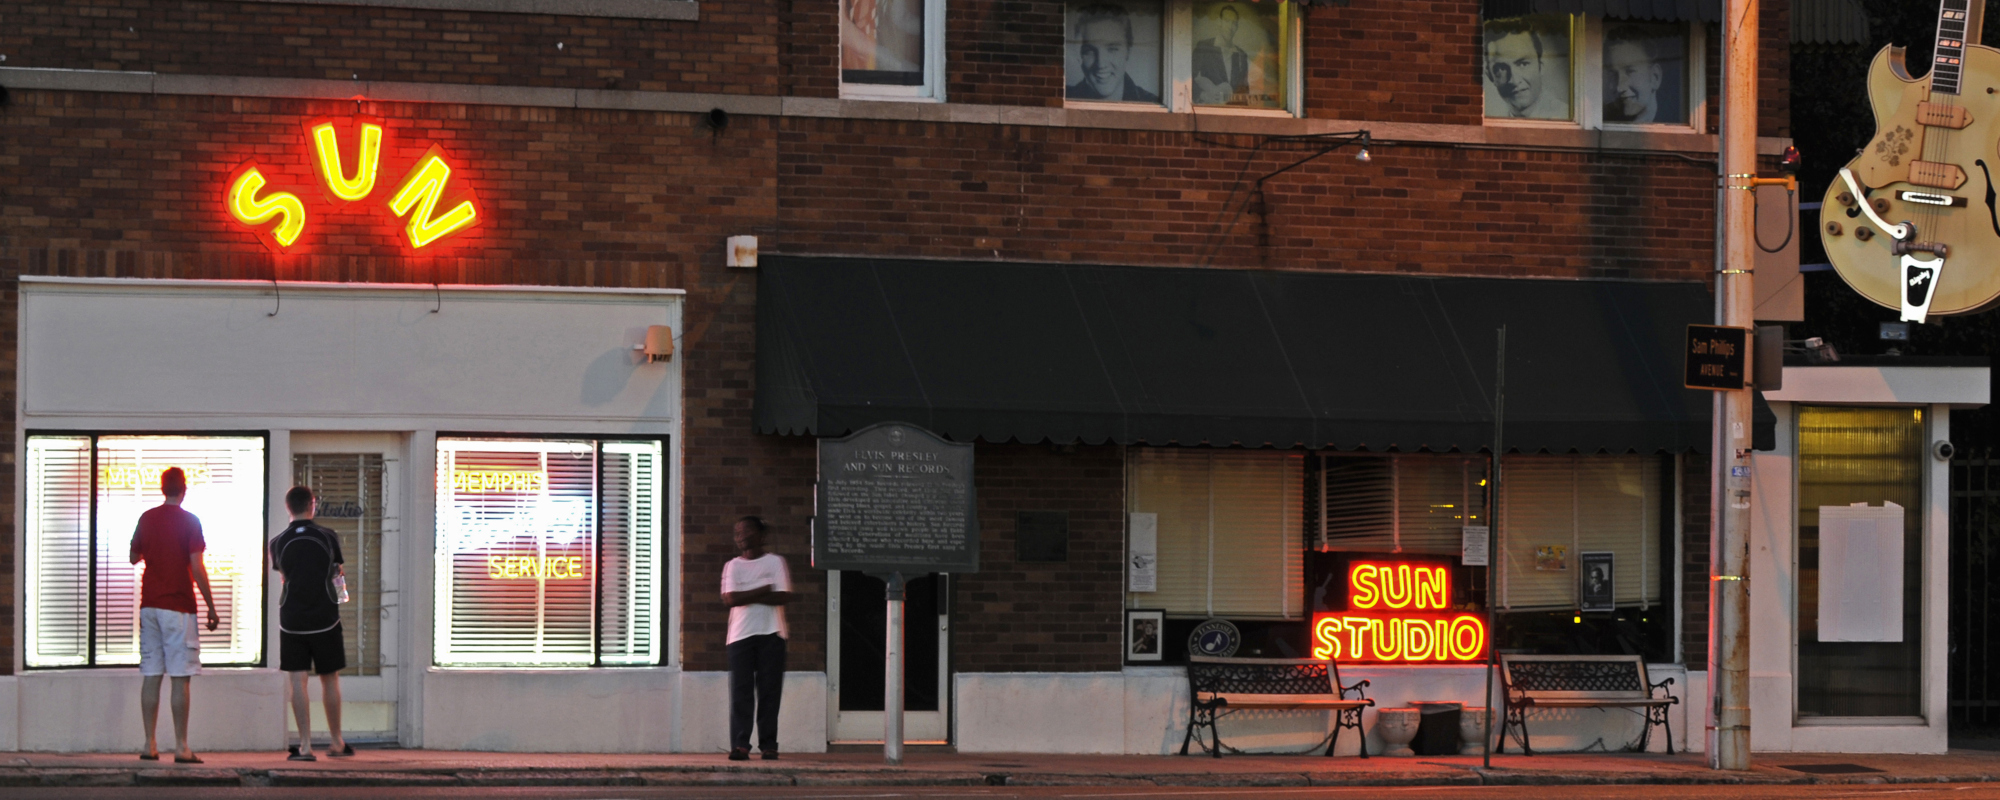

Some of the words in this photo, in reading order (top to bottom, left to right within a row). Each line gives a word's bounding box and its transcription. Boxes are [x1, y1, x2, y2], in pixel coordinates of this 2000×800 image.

[228, 121, 477, 248] SUN
[1692, 338, 1708, 354] Sam
[1710, 339, 1735, 359] Phillips
[1700, 364, 1724, 377] AVENUE
[854, 450, 885, 460] ELVIS
[891, 451, 938, 461] PRESLEY
[104, 465, 211, 487] MEMIS
[843, 462, 867, 472] AND
[871, 463, 893, 473] SUN
[898, 464, 950, 474] RECORDS
[452, 472, 546, 493] MEMPHIS
[489, 556, 584, 579] SERVICE
[1352, 564, 1447, 609] SUN
[1197, 623, 1234, 635] TENNESSEE
[1314, 615, 1484, 661] STUDIO
